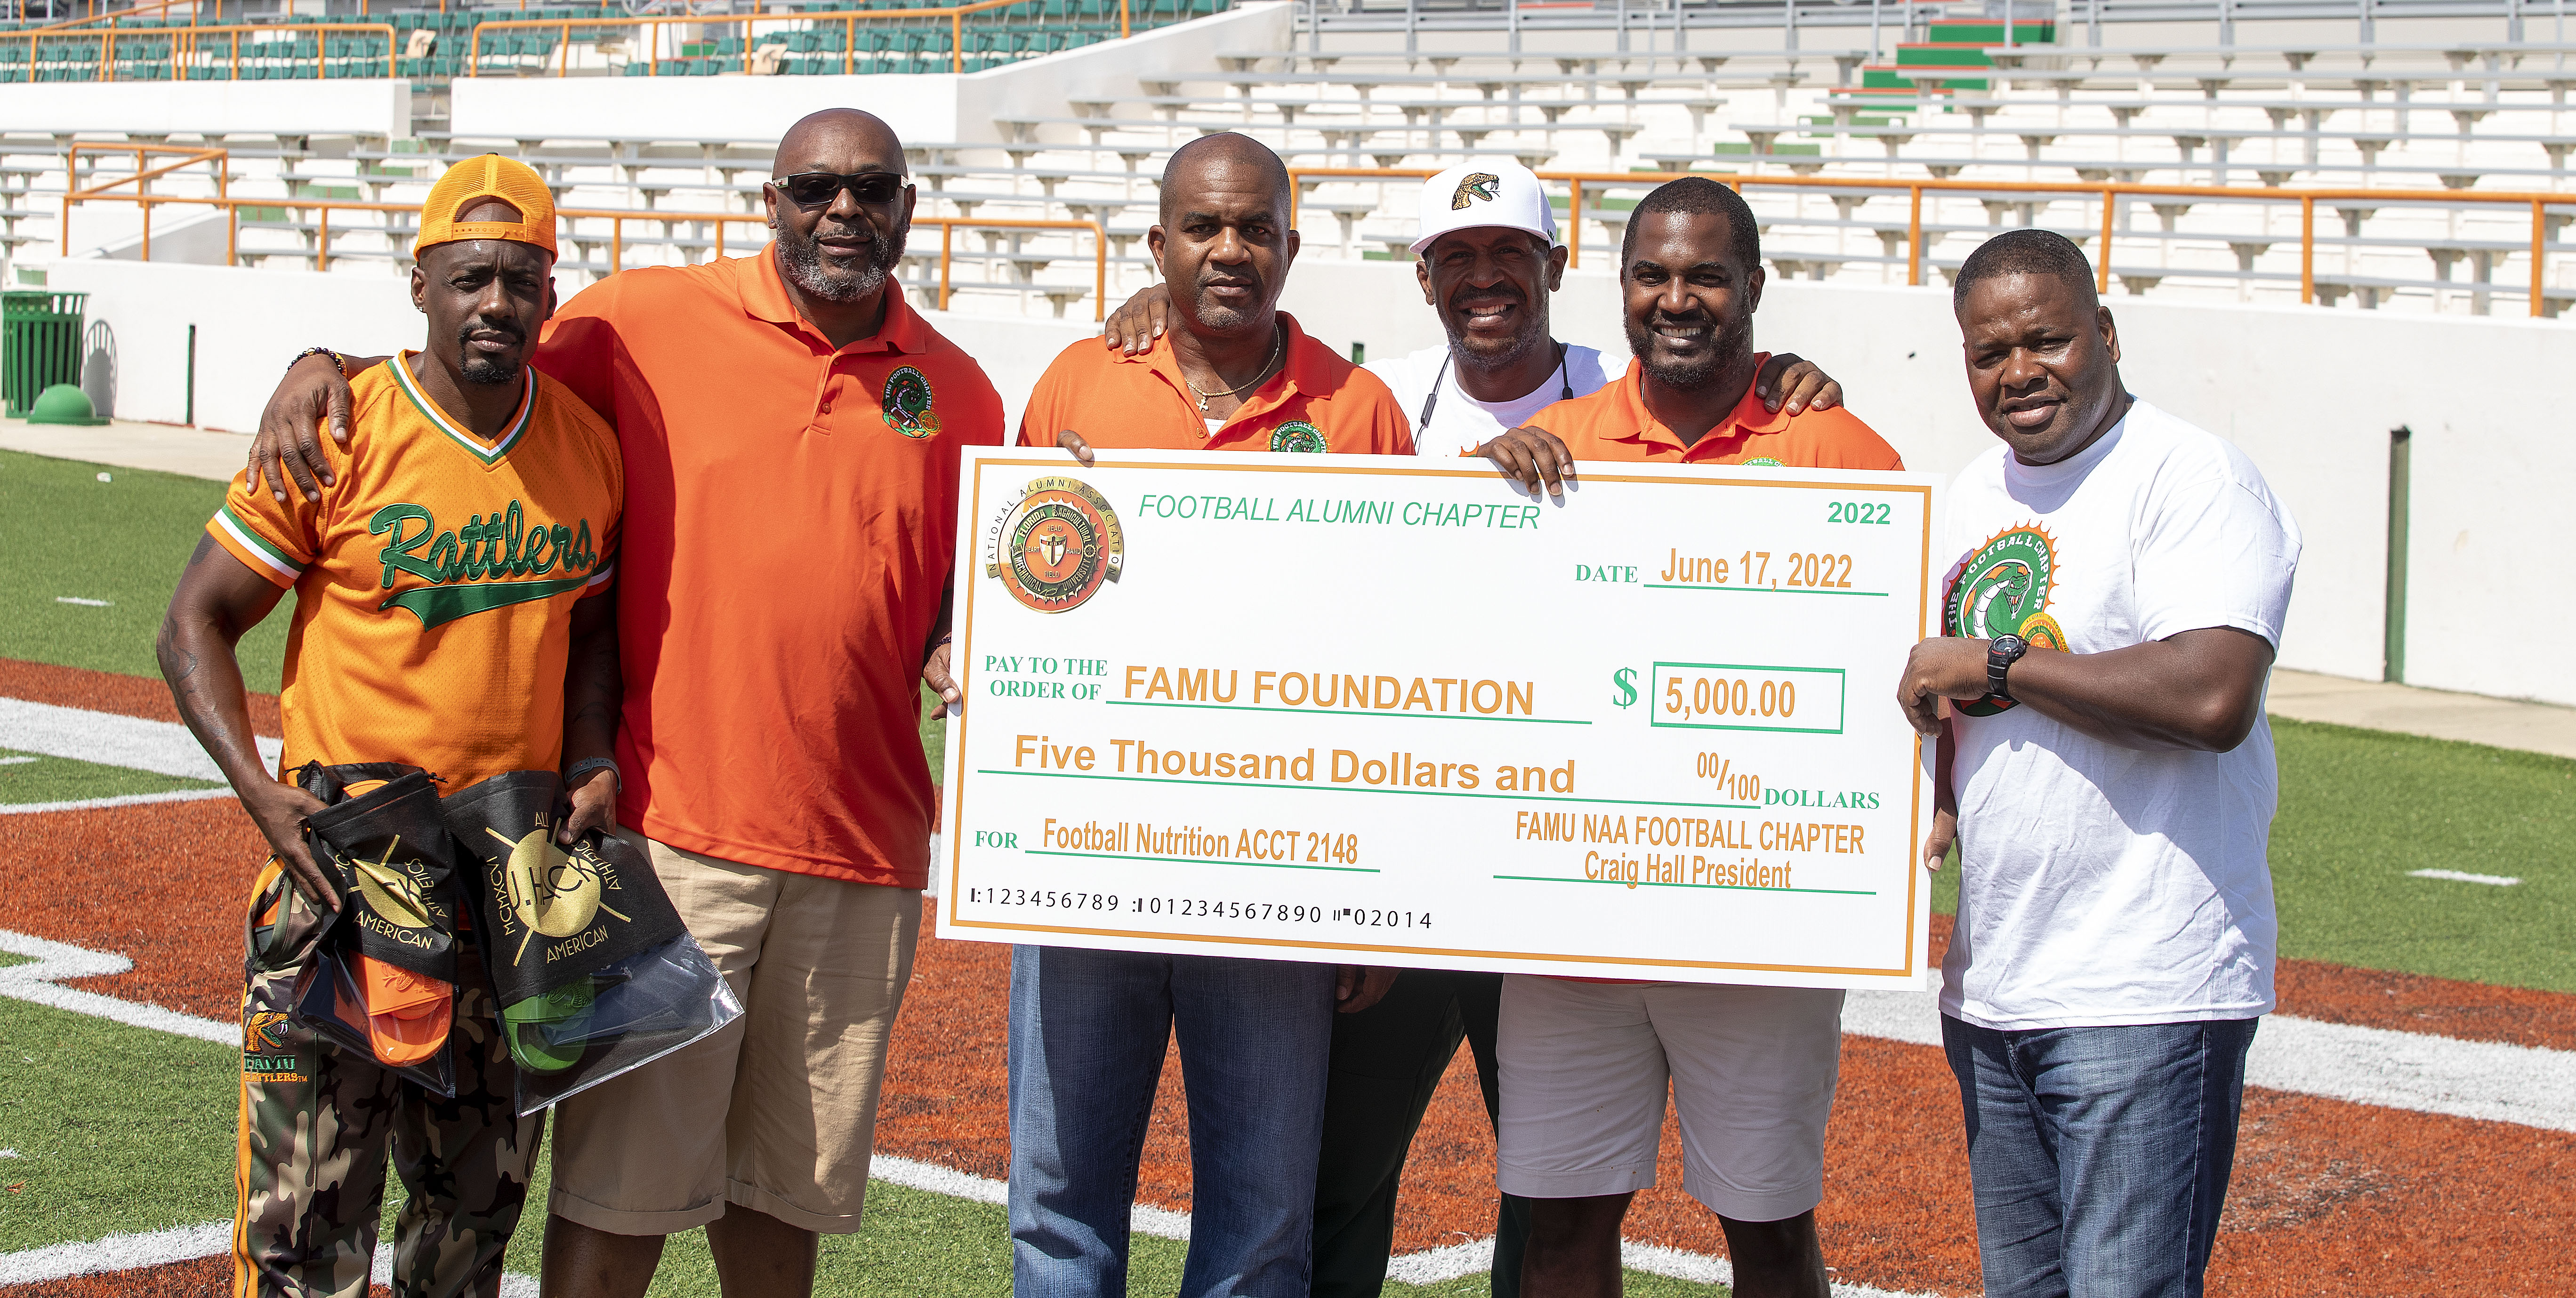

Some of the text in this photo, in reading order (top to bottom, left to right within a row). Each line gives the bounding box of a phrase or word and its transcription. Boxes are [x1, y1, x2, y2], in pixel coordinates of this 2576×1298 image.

[890, 368, 919, 383] FOOTBALL
[920, 377, 932, 410] CHAPTER
[1276, 422, 1312, 436] FOOTBALL
[1312, 428, 1327, 453] CHAPTE
[988, 479, 1120, 576] NATIONAL ALUMNI ASSOCIATION
[1018, 508, 1091, 544] FLORIDA AGRICULTURAL
[1139, 495, 1540, 529] FOOTBALL ALUMNI CHAPTER
[1828, 502, 1891, 524] 2022
[369, 499, 596, 588] Rattlers
[1014, 556, 1091, 592] MECHANICAL UNIVERSITY
[1576, 549, 1852, 592] DATE June 17, 2022
[2034, 540, 2049, 610] CHAPTER
[985, 656, 1107, 676] PAY TO THE
[990, 680, 1101, 700] ORDER OF
[1125, 666, 1533, 715] FAMU FOUNDATION
[1613, 667, 1795, 721] $ 5,000.00
[1015, 735, 1095, 770] Five
[1111, 739, 1314, 781] Thousand
[1331, 750, 1479, 789] Dollars
[1496, 760, 1574, 793] and
[1765, 789, 1879, 809] DOLLARS
[975, 831, 1017, 849] FOR
[1044, 818, 1357, 864] Football Nutrition ACCT 2148
[1517, 811, 1864, 854] FAMU NAA FOOTBALL CHAPTER
[1586, 851, 1791, 889] Craig Hall President
[353, 910, 433, 950] AMERICAN
[547, 925, 609, 964] AMERICAN
[244, 1055, 296, 1072] FAMU
[245, 1073, 298, 1082] RATTLERS
